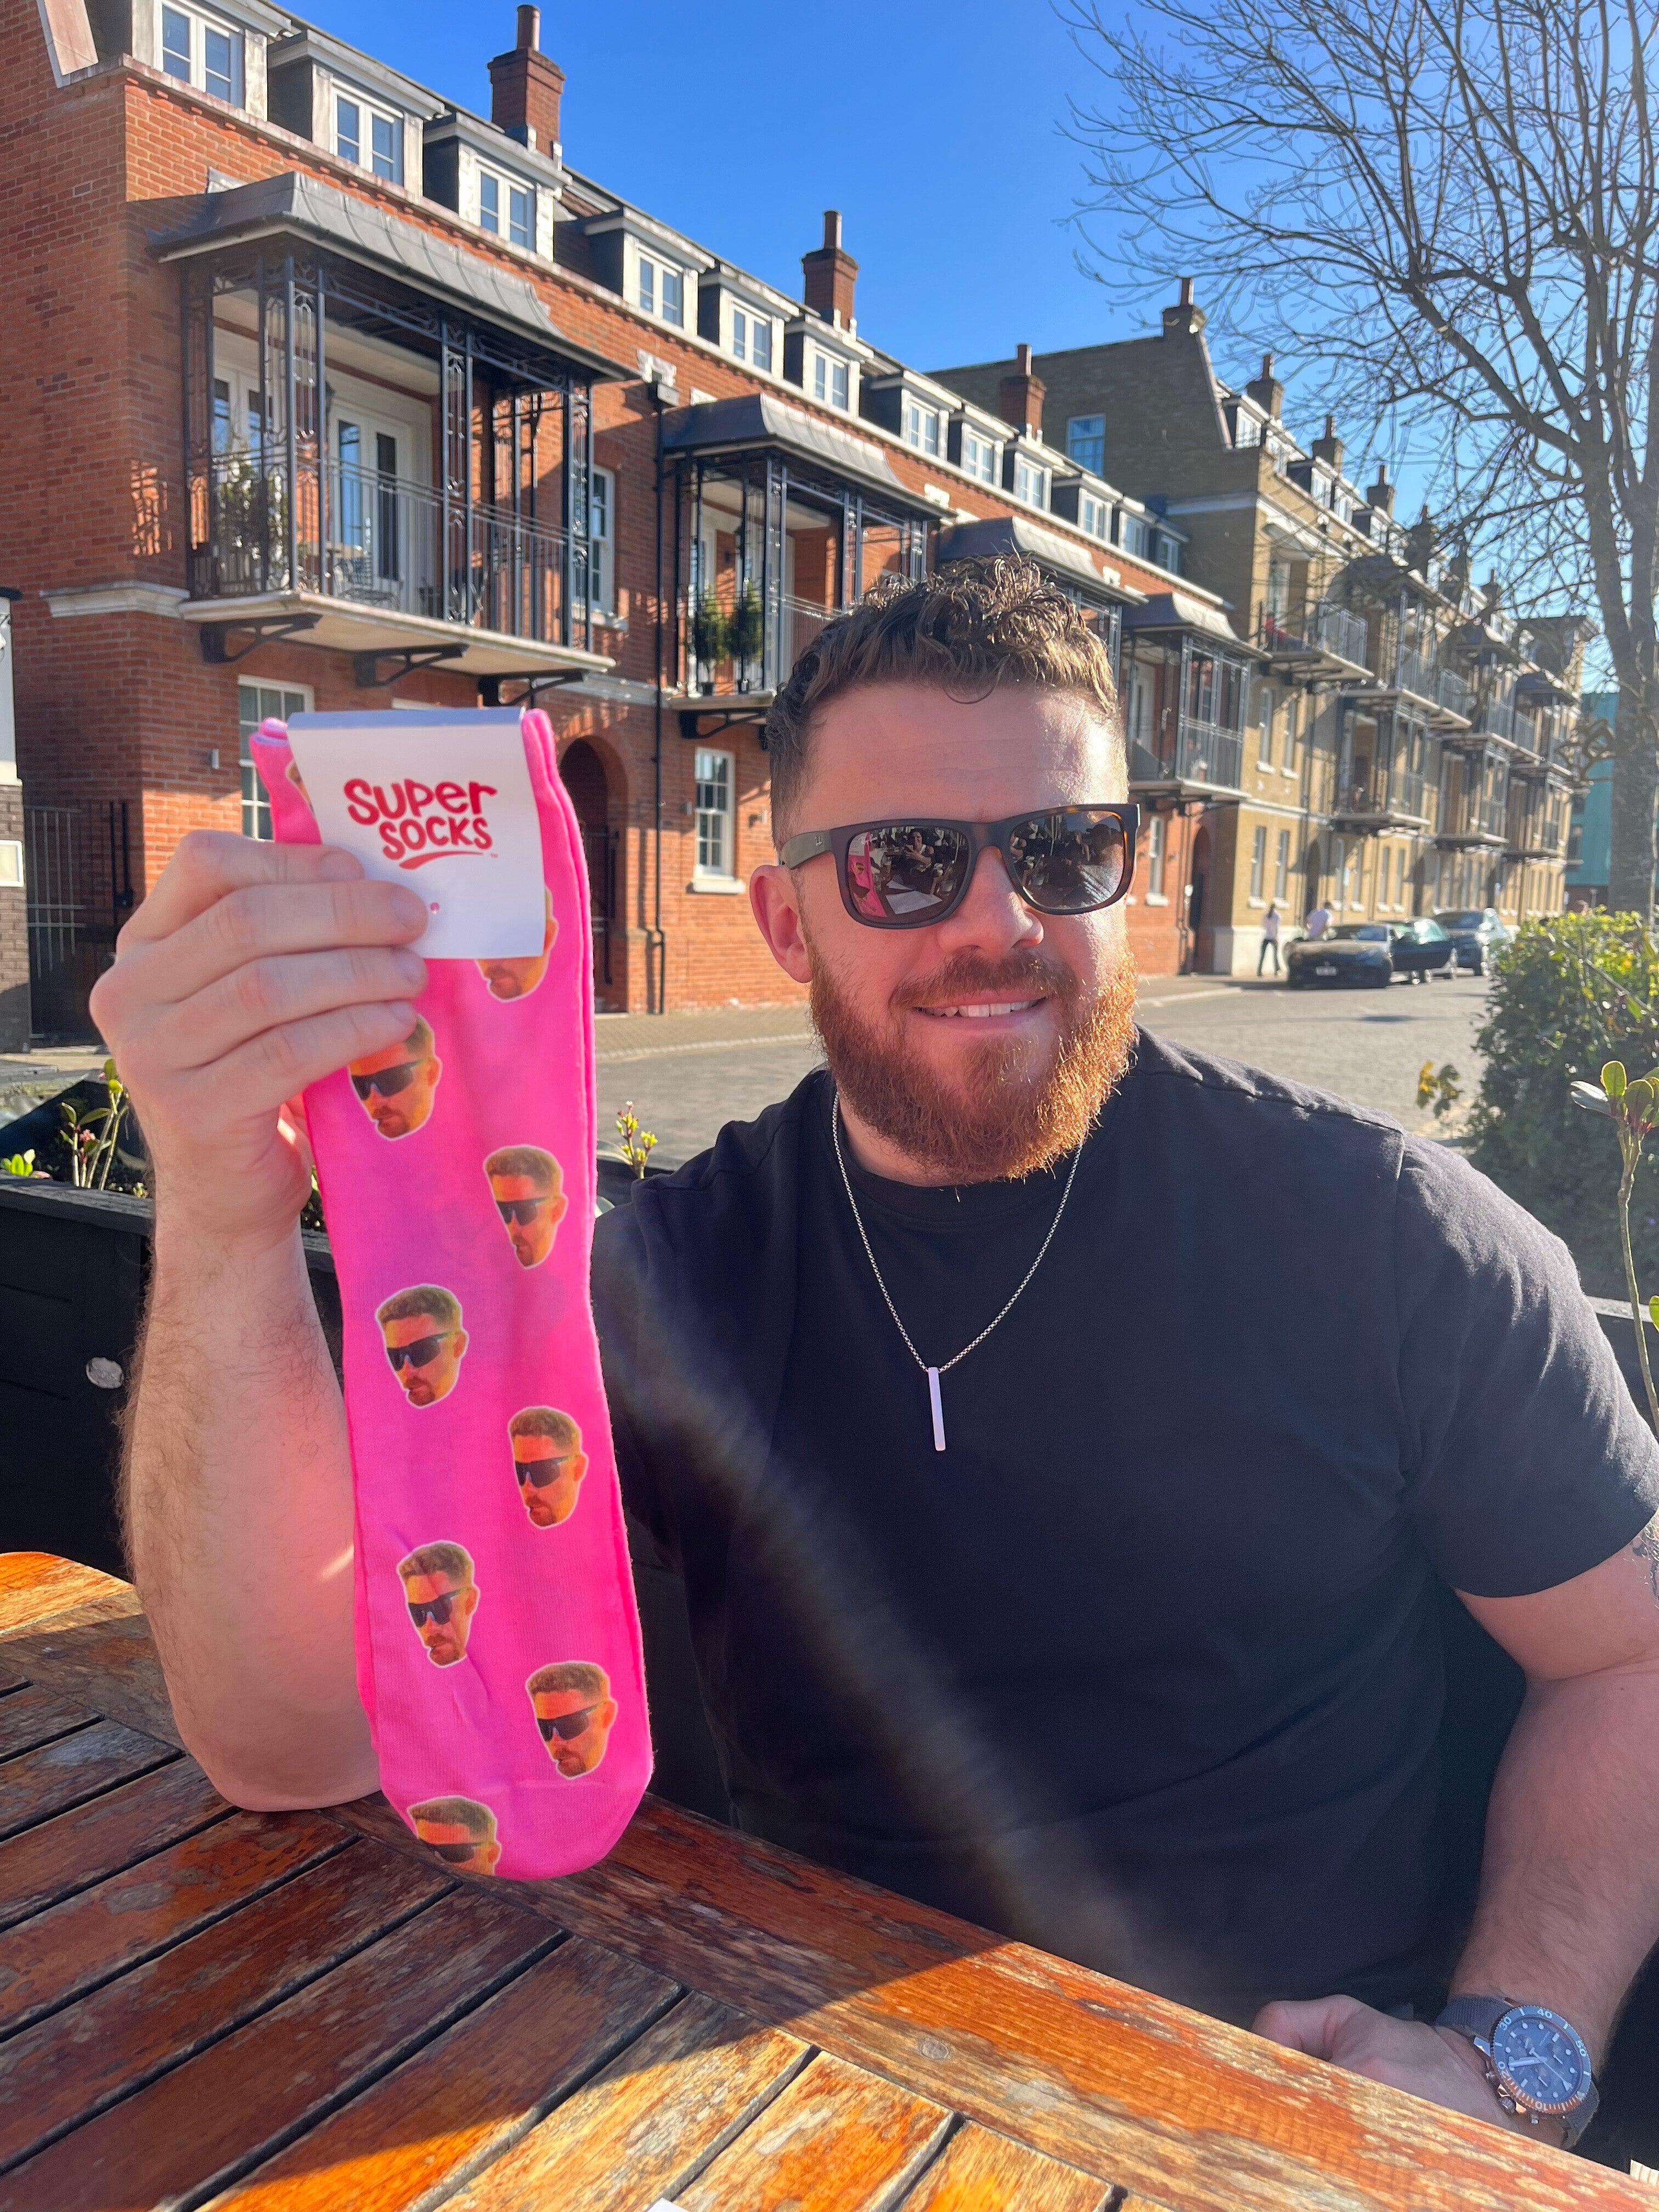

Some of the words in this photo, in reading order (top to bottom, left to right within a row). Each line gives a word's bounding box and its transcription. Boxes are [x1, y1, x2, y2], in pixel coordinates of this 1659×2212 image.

[378, 816, 493, 860] SOCKS
[1537, 2008, 1553, 2019] 40
[1499, 2016, 1512, 2031] 30
[1575, 2040, 1587, 2057] 50
